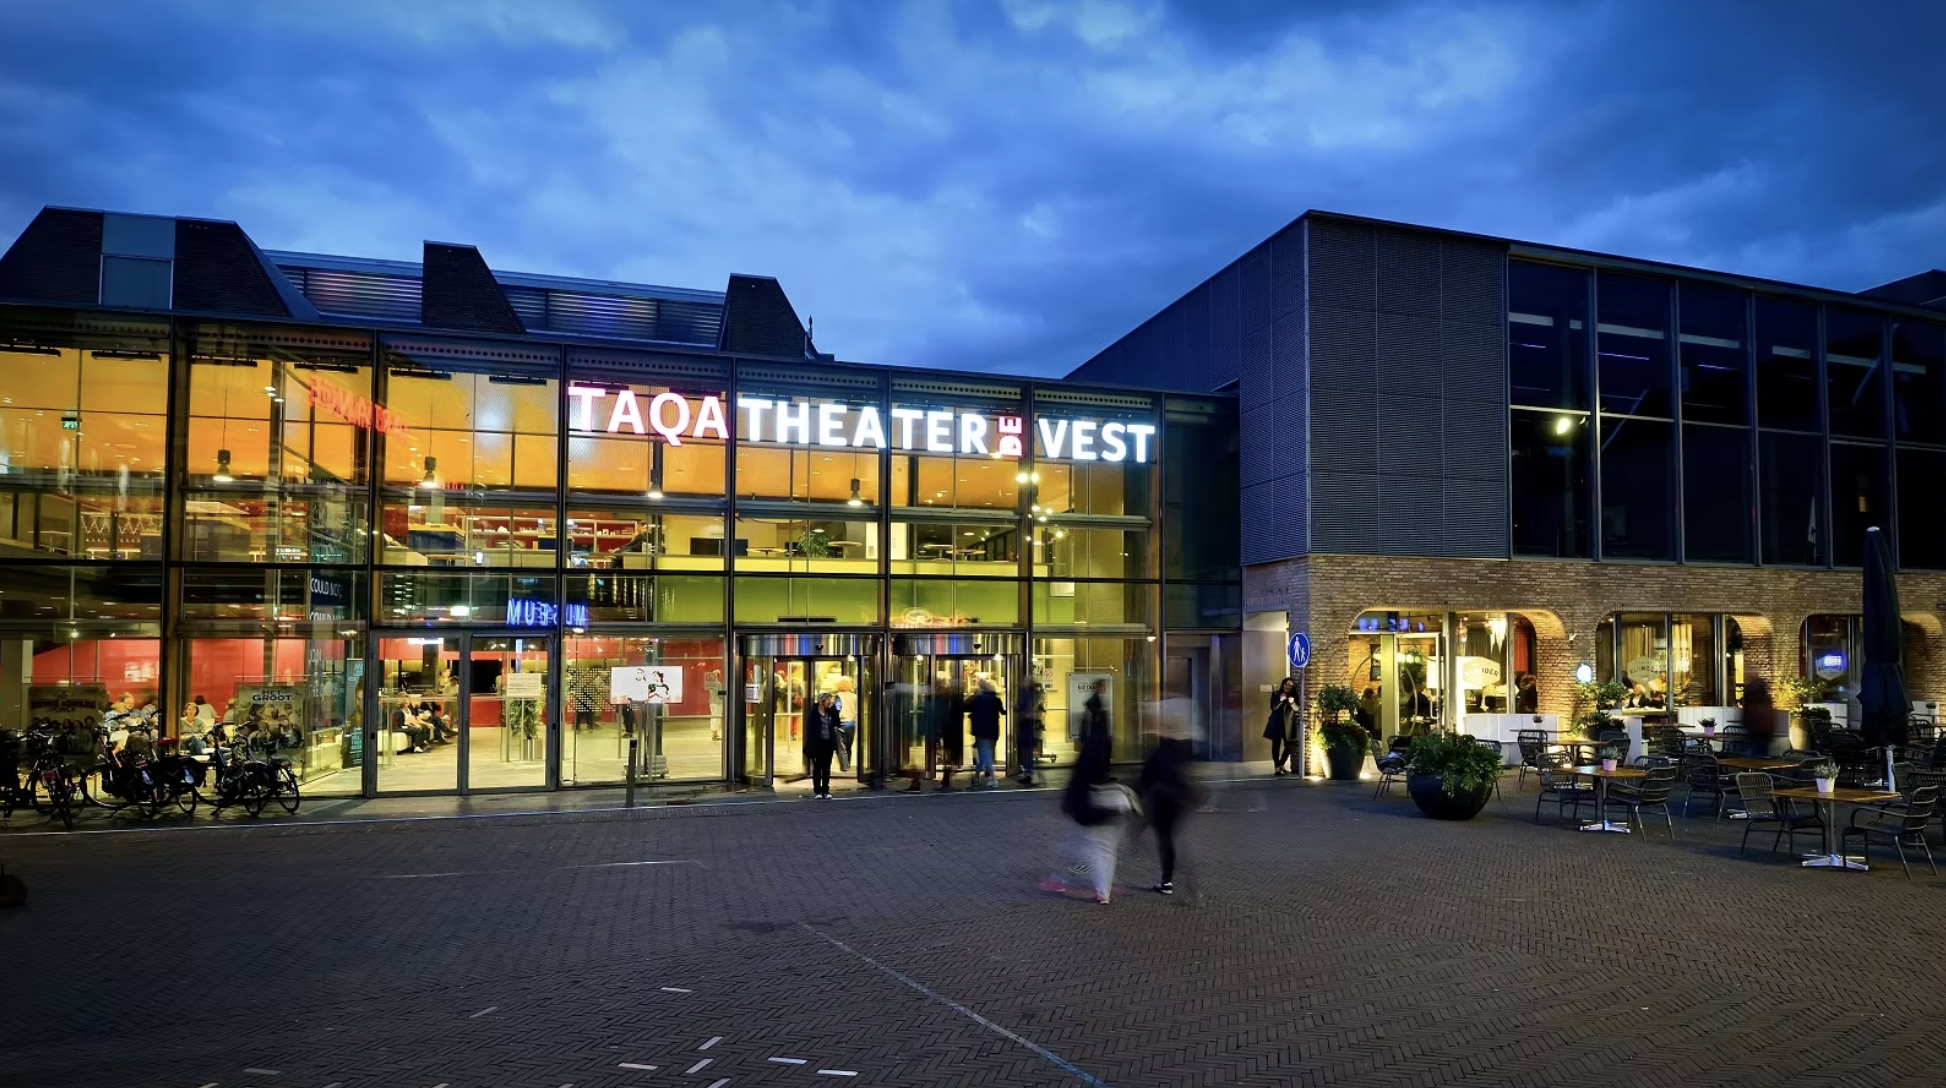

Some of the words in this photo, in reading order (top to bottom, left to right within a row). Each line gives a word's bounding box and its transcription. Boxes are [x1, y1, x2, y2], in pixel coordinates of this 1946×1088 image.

[568, 386, 730, 446] TAQA
[737, 397, 989, 455] THEATER
[998, 415, 1023, 457] DE
[1038, 418, 1156, 463] VEST
